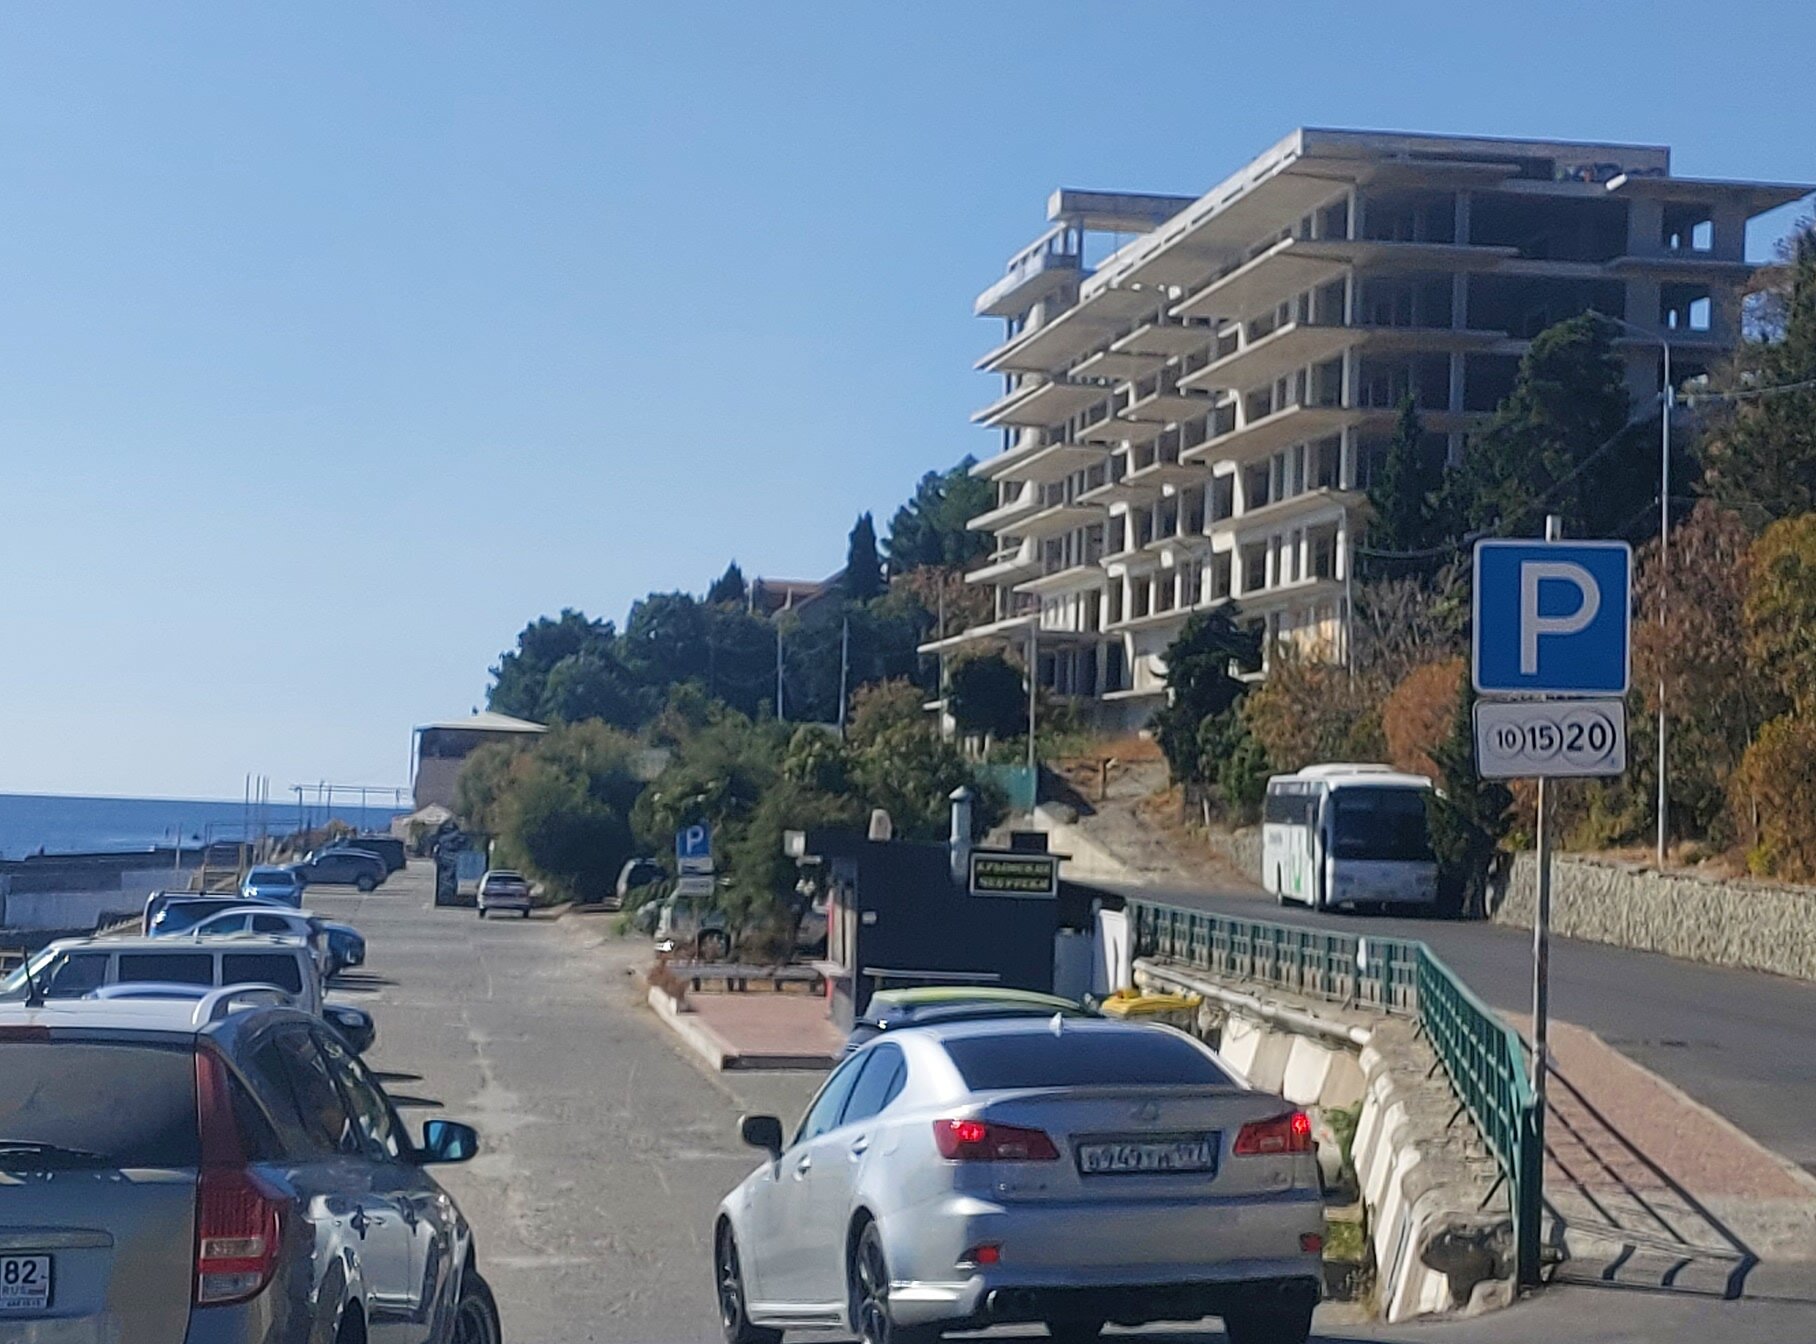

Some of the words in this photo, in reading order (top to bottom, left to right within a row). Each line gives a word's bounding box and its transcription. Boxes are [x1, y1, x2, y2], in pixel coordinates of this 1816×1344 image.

[1520, 560, 1601, 676] P
[1496, 728, 1517, 750] 10
[1530, 725, 1555, 751] 15
[1566, 722, 1607, 752] 20
[686, 824, 704, 855] P
[4, 1259, 37, 1285] 82
